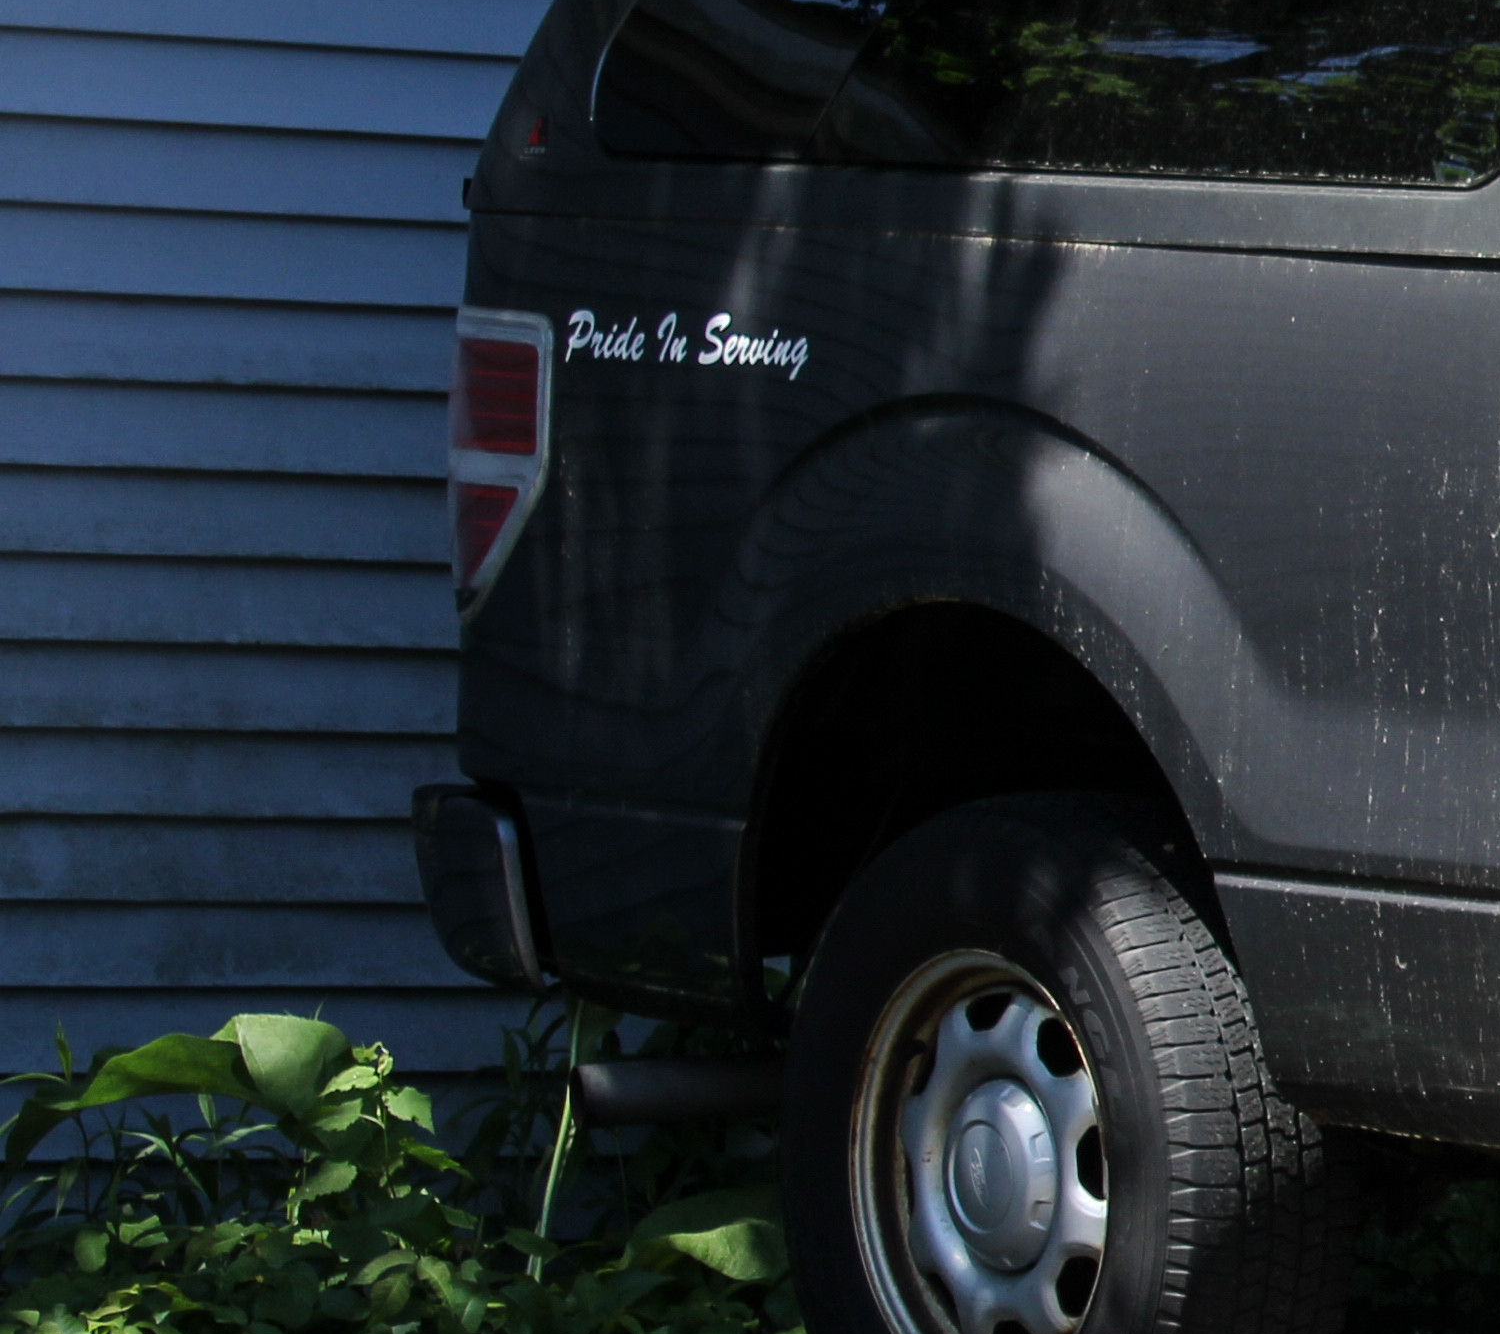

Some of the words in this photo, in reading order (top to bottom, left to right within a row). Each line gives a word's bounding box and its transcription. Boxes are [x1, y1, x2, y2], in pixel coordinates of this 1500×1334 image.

[565, 309, 646, 363] Pride
[656, 311, 688, 363] In
[698, 311, 810, 381] Serving
